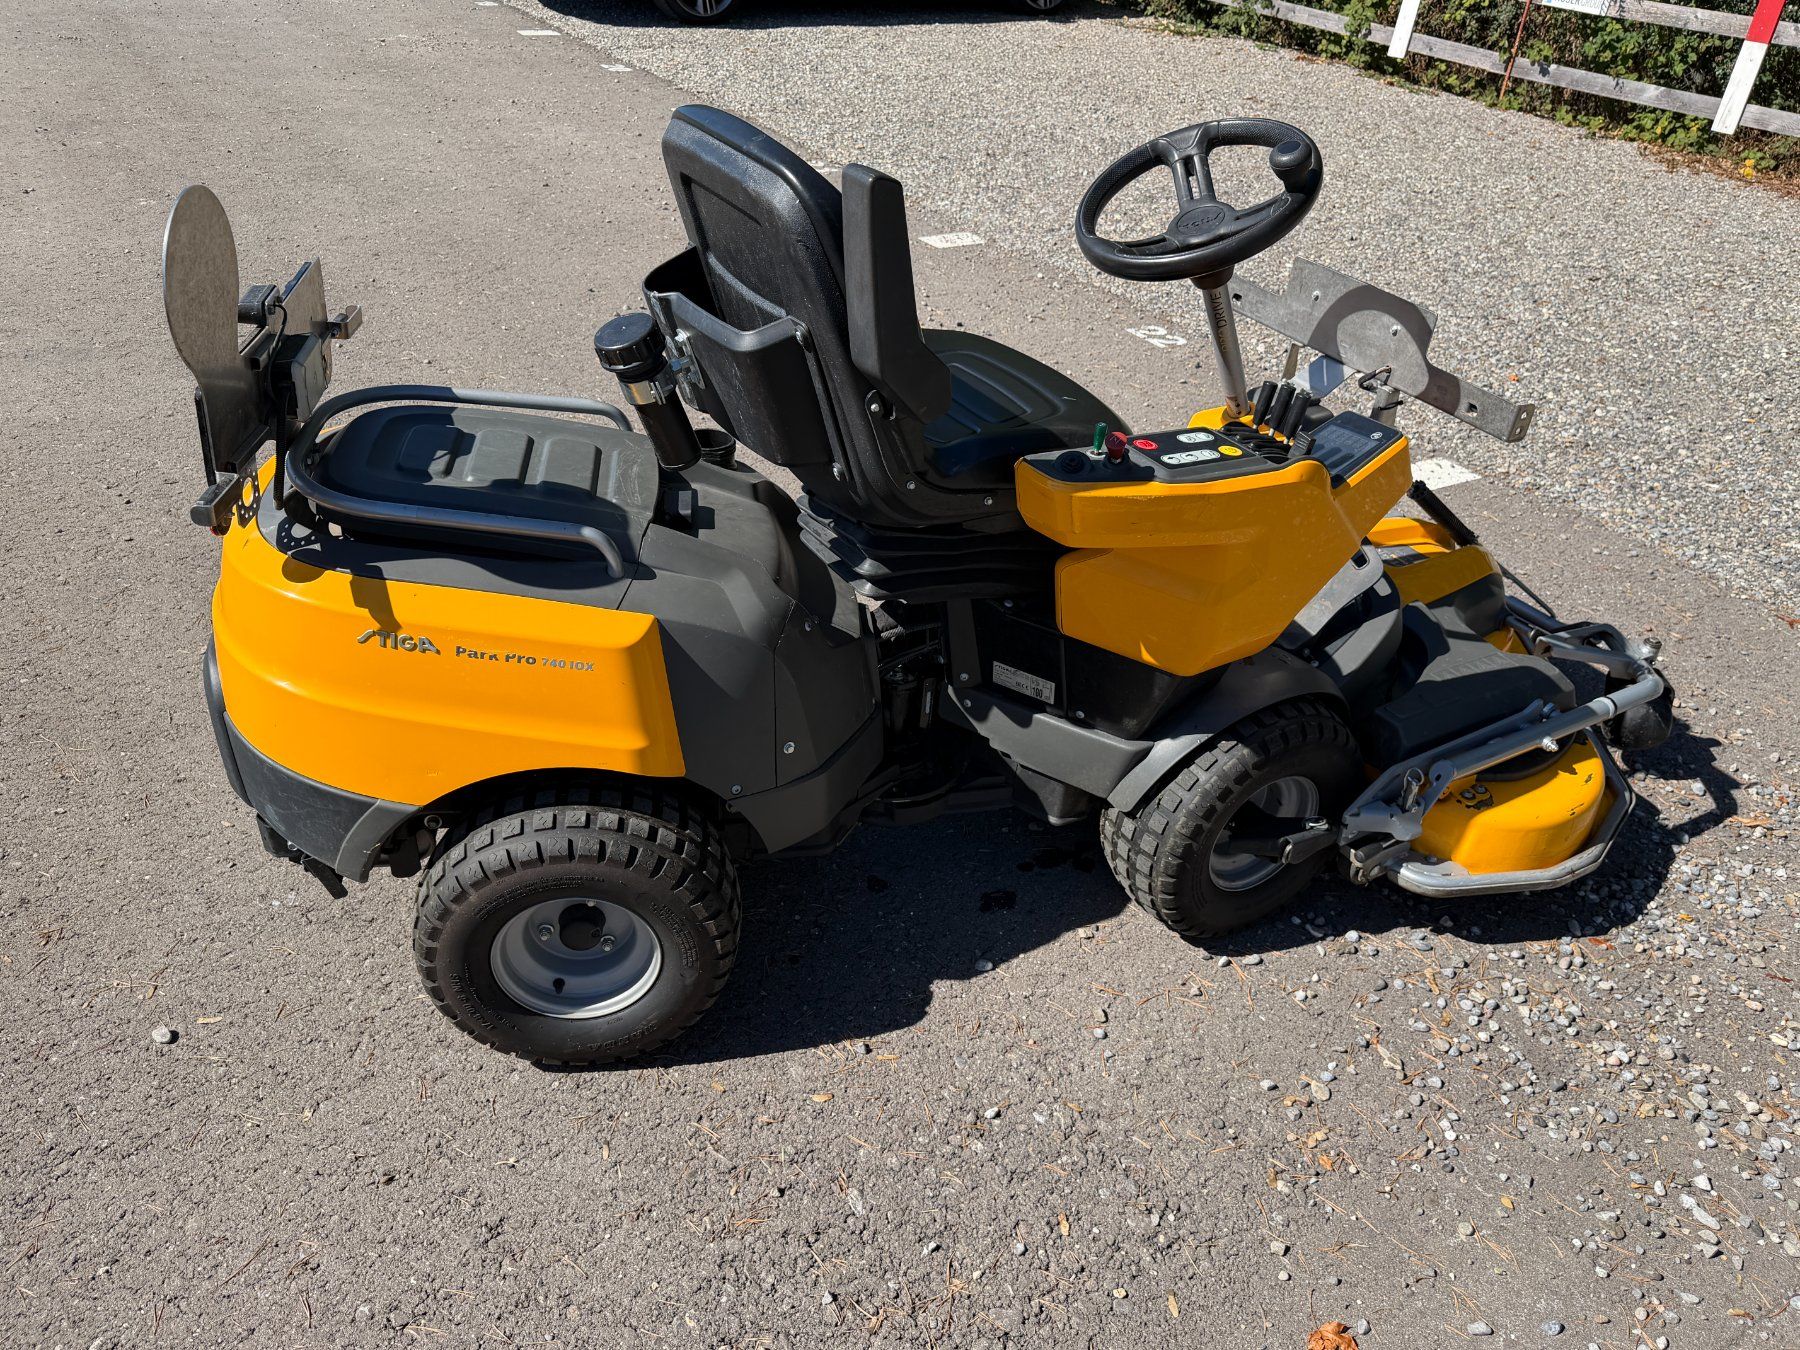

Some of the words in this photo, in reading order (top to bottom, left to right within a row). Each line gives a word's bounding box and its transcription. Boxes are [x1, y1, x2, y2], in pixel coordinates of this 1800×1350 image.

[1210, 291, 1228, 328] DRIVE
[357, 629, 441, 655] STIGA
[455, 645, 499, 662] Park
[504, 653, 537, 665] Pro
